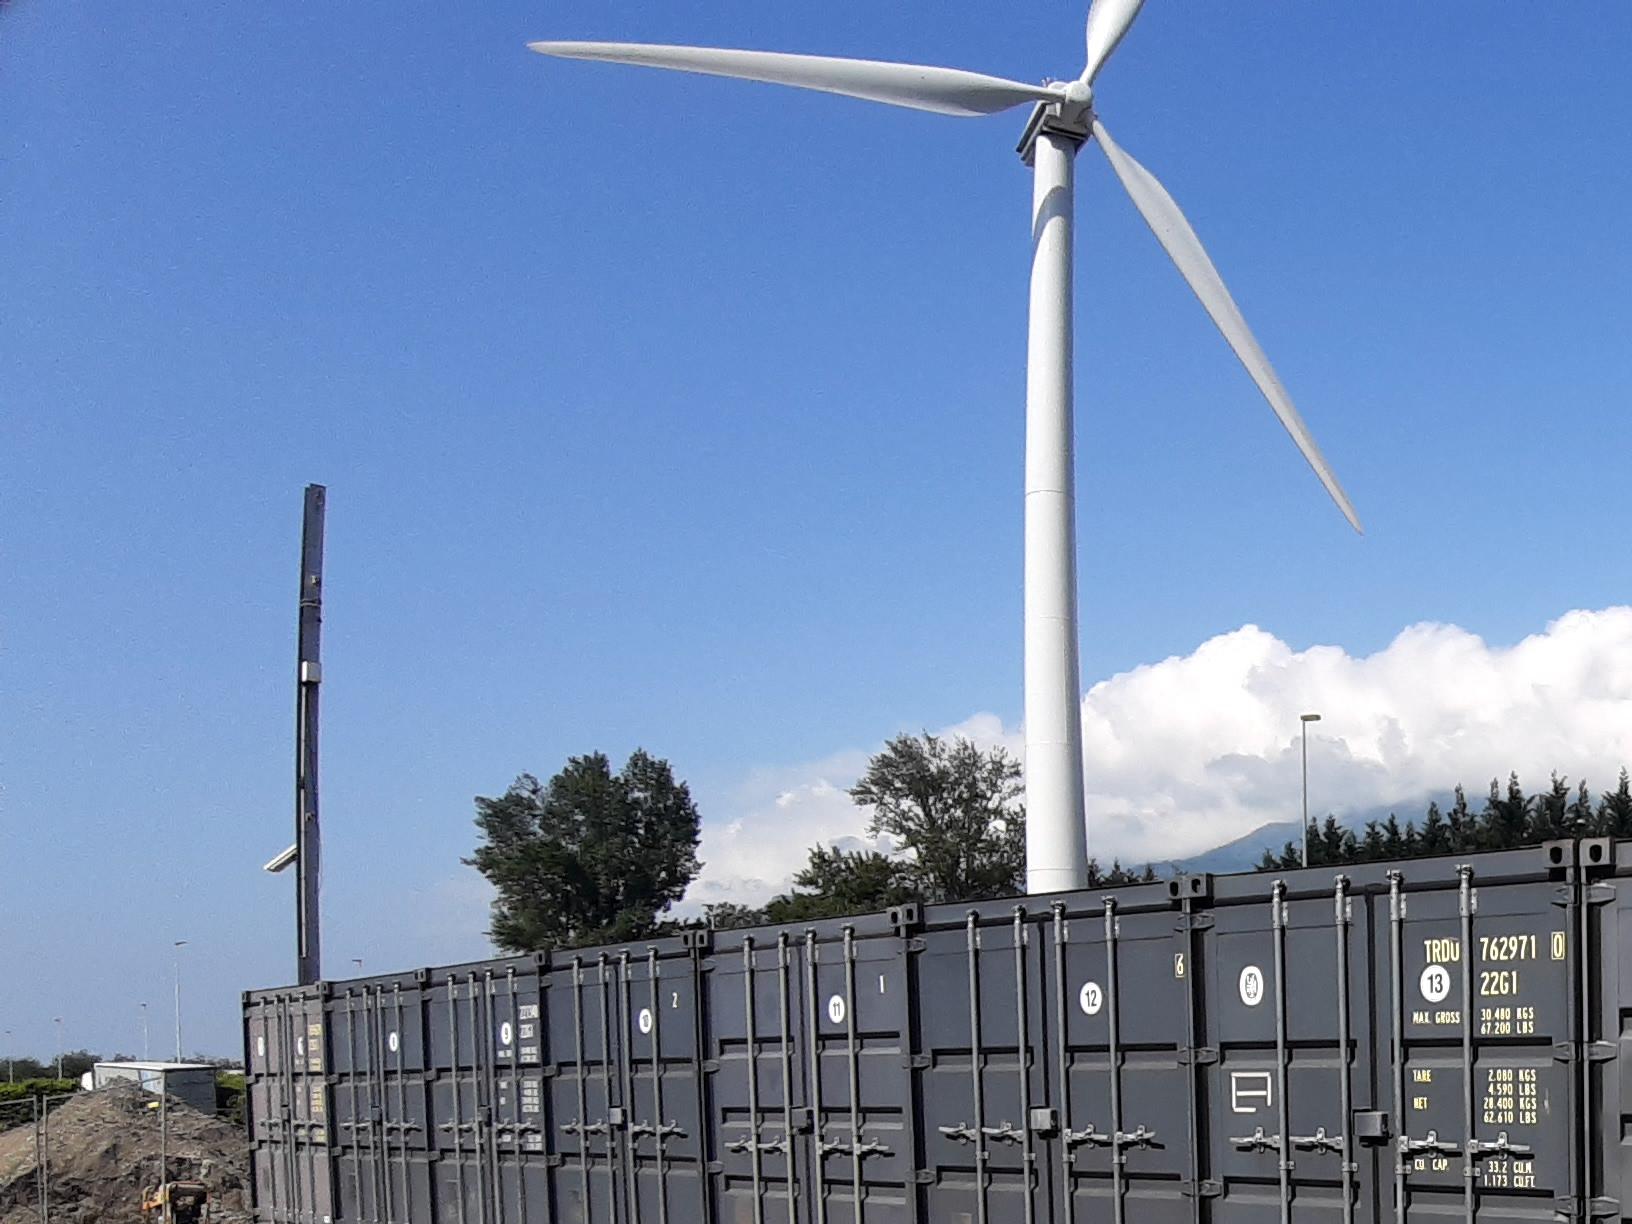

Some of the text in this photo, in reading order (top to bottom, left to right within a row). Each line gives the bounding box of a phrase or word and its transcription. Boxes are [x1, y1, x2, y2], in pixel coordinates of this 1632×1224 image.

[1424, 939, 1460, 963] TRDU
[1479, 935, 1536, 961] 762971
[1427, 974, 1443, 993] 13
[1480, 970, 1517, 996] 22G1
[1085, 990, 1097, 1007] 12
[1435, 1011, 1461, 1024] GROSS
[1412, 1069, 1432, 1082] TARE
[1518, 1083, 1537, 1096] LBS
[1519, 1097, 1537, 1110] KGS
[1519, 1110, 1537, 1124] LBS
[1484, 1174, 1508, 1187] 1.173
